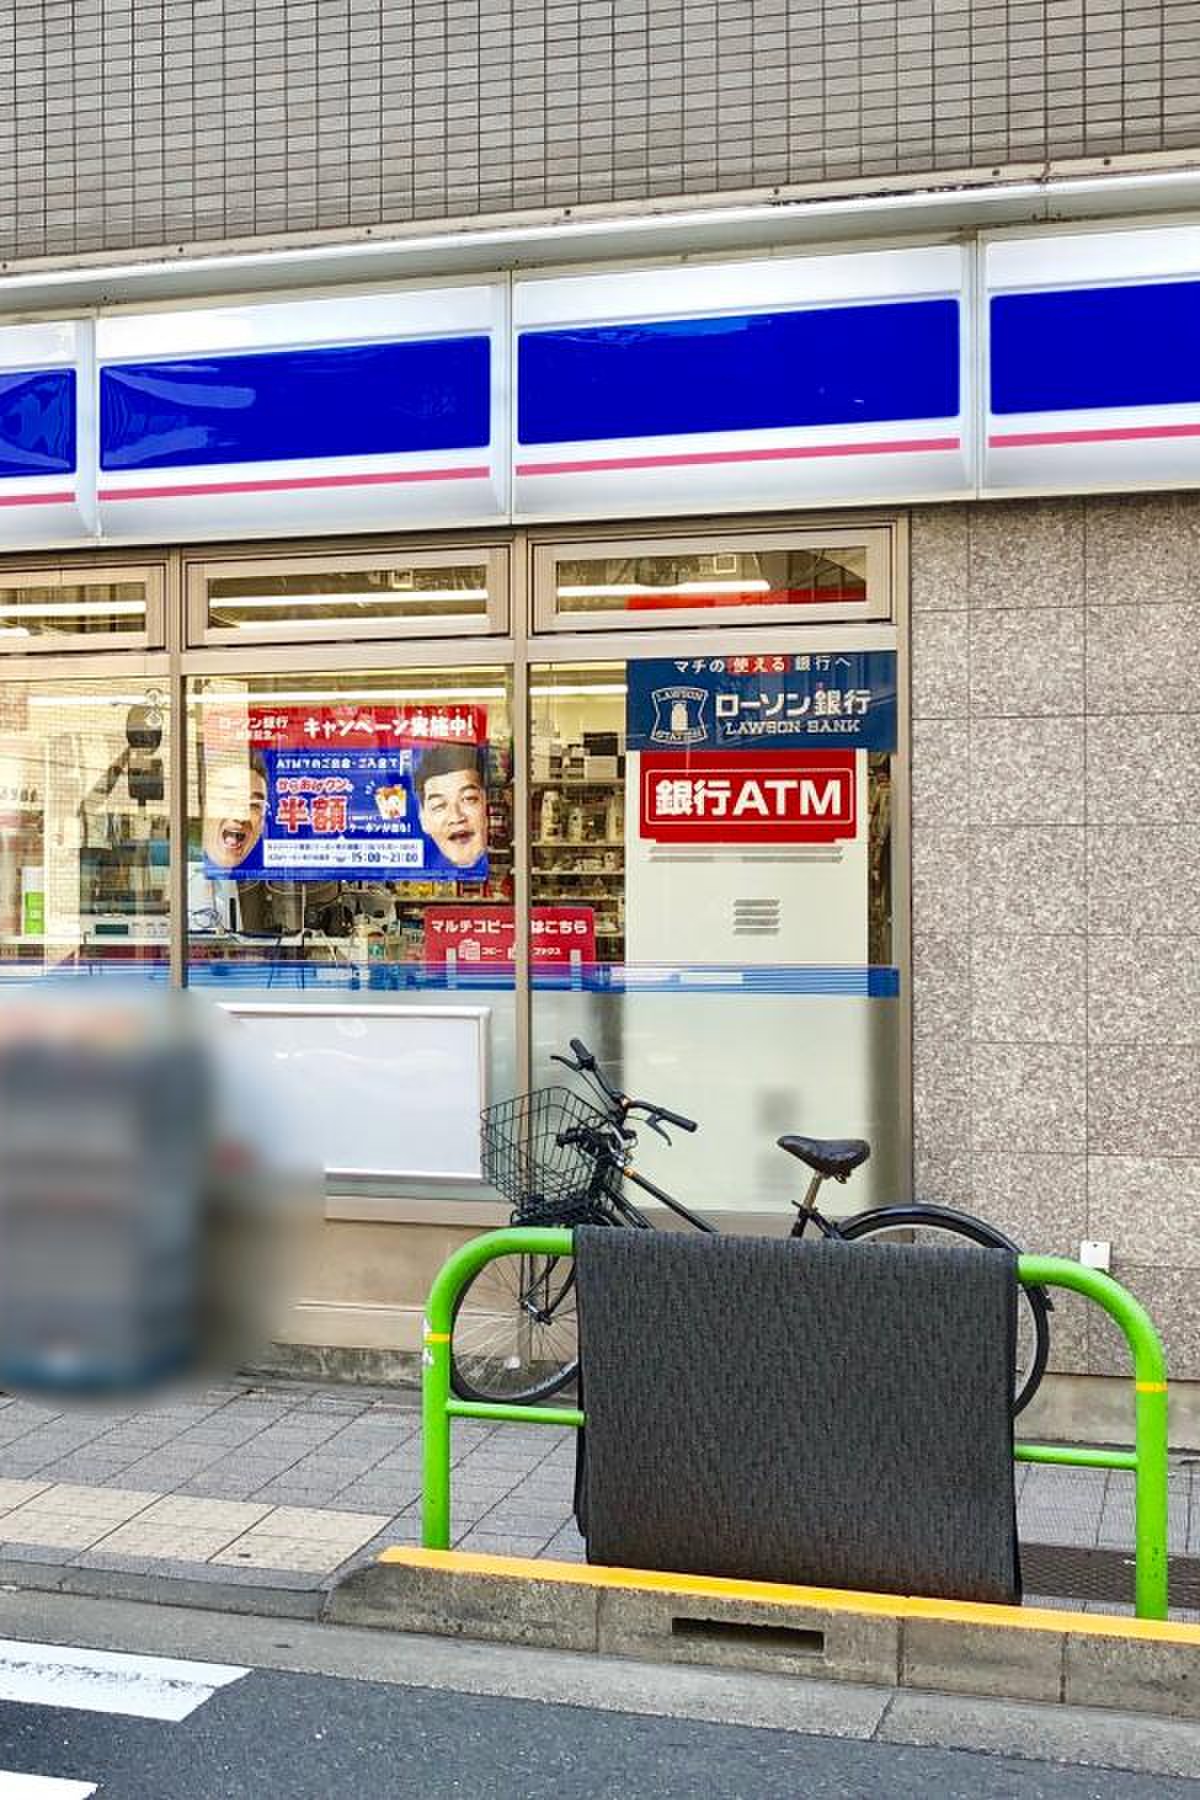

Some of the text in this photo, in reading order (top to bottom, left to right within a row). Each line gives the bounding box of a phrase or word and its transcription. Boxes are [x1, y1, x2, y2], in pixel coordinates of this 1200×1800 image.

[715, 688, 872, 717] ローソン銀行
[303, 714, 474, 739] キャンペーン実施中!
[725, 719, 862, 736] LAWSON BANK
[655, 779, 842, 817] 銀行ATM
[275, 796, 348, 833] 半額
[431, 919, 588, 935] マルチコピーはこちら
